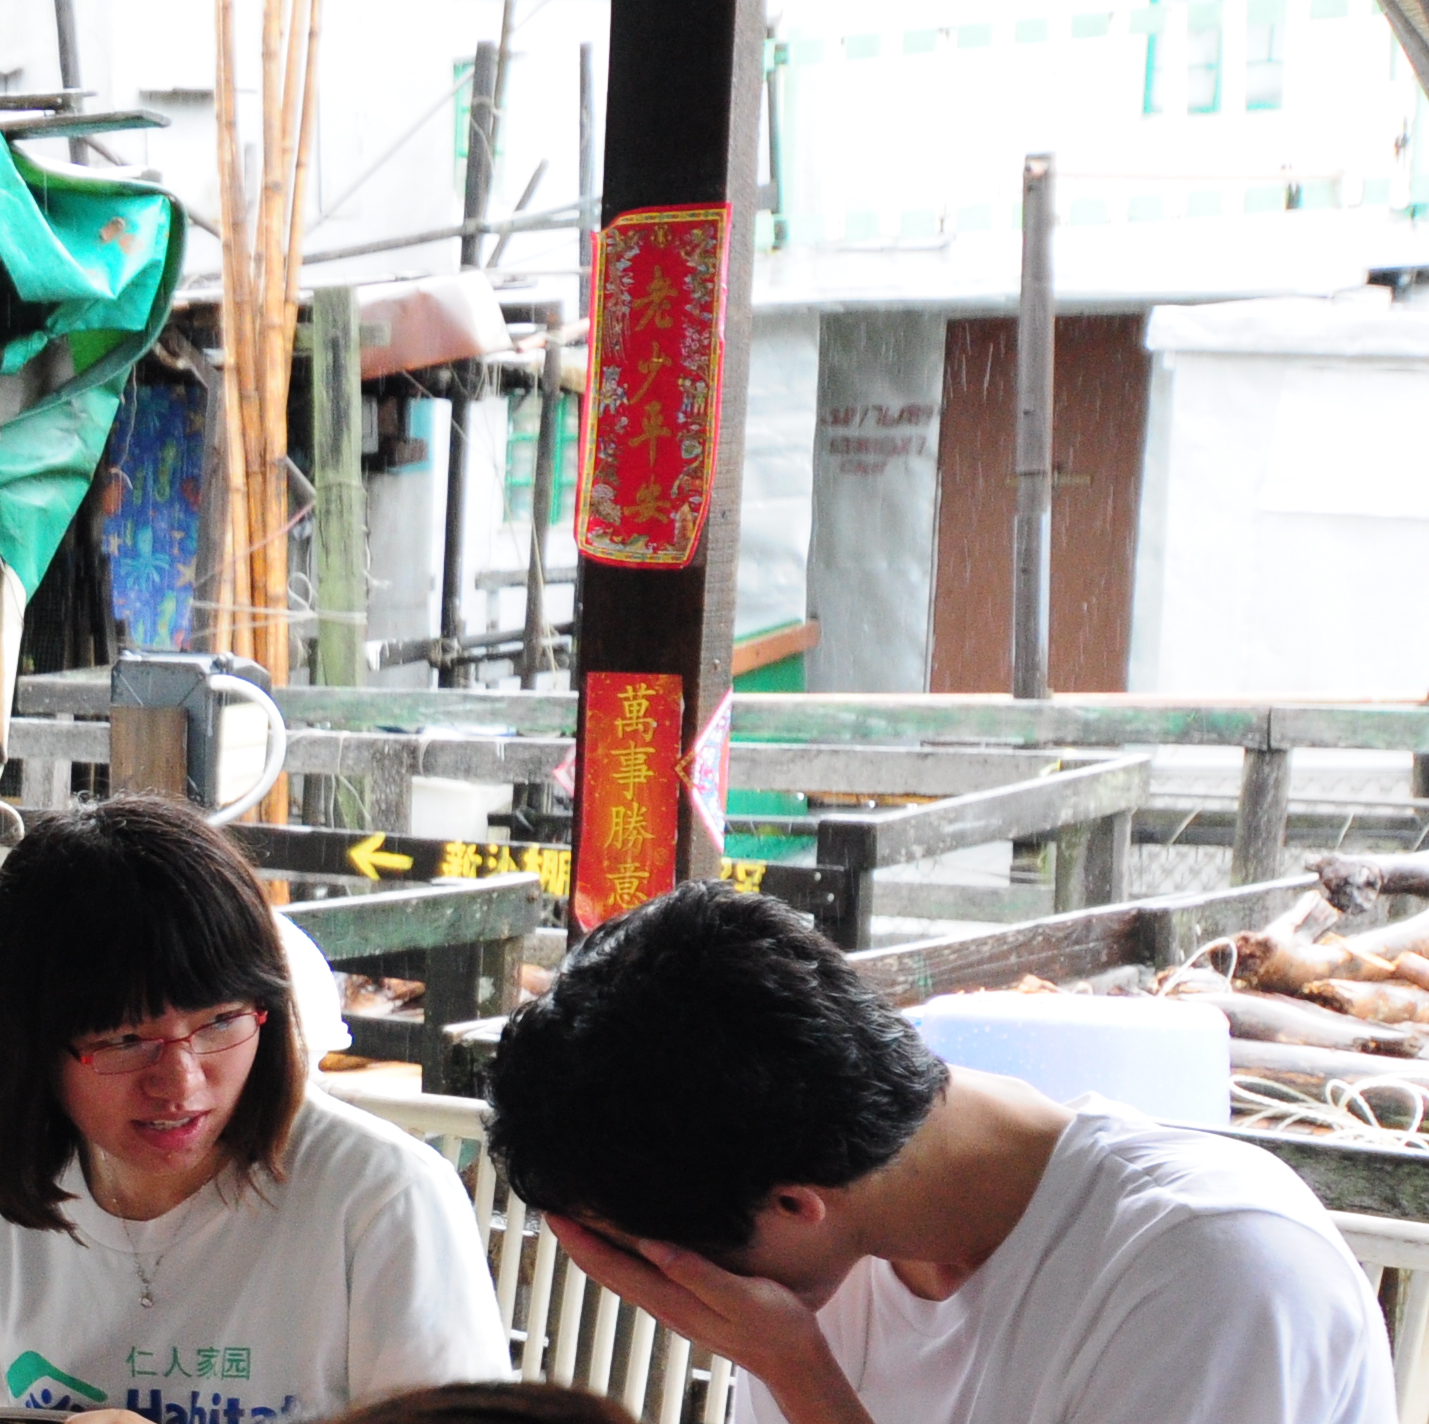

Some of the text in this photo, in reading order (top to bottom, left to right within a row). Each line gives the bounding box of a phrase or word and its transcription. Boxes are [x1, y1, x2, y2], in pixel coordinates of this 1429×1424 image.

[623, 263, 679, 524] 老少平安
[603, 682, 657, 910] 萬事勝意
[126, 1345, 251, 1381] 仁人家园
